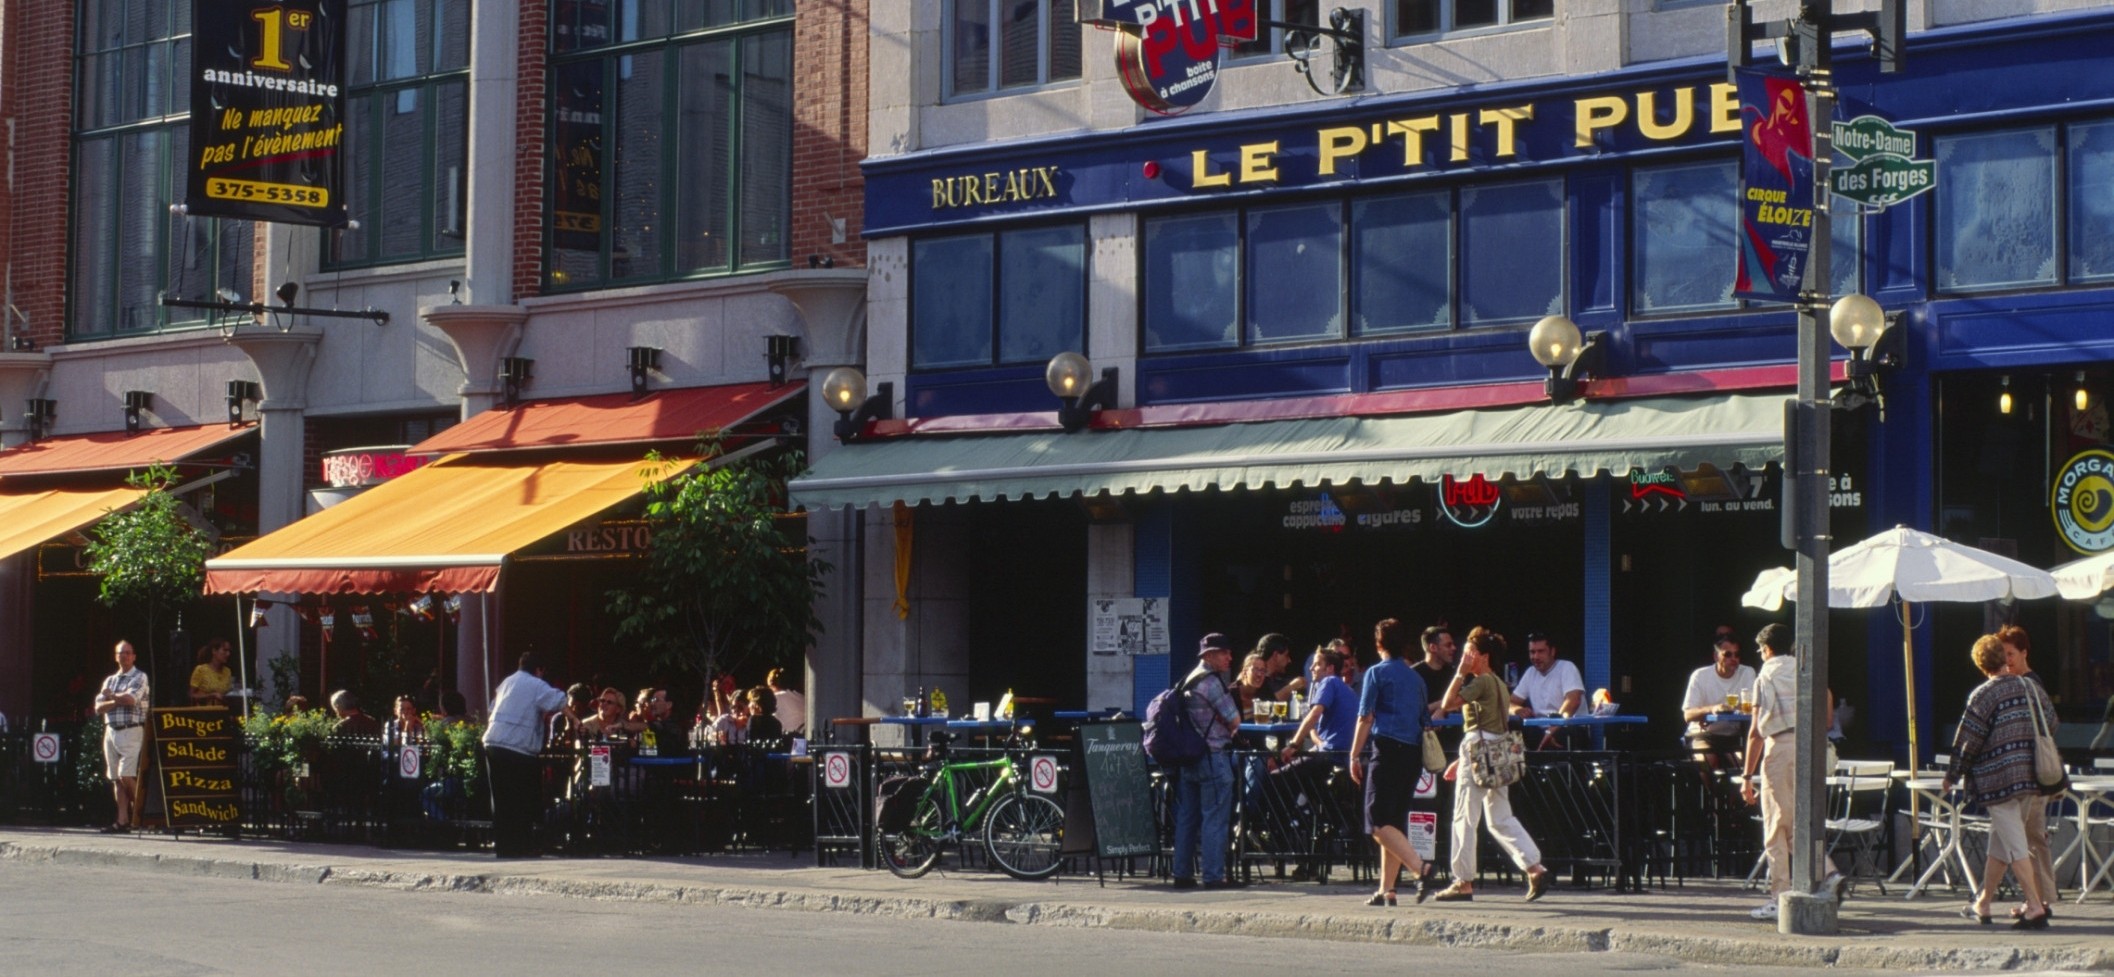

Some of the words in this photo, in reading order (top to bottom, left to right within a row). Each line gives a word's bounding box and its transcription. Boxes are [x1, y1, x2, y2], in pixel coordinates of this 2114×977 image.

[251, 6, 312, 72] 1er
[203, 68, 338, 97] anniversaire
[1160, 86, 1169, 99] à
[1169, 70, 1215, 96] chansons
[221, 107, 243, 130] Ne
[249, 104, 323, 131] manquez
[201, 142, 235, 170] pas
[242, 123, 343, 160] l'évènement
[1192, 140, 1279, 188] LE
[1318, 103, 1534, 175] P'TIT
[1835, 126, 1911, 154] Notre-Dame
[932, 166, 1058, 208] BUREAUX
[1838, 170, 1867, 191] des
[1872, 168, 1928, 191] Forges
[214, 181, 320, 204] 375-5358
[1747, 187, 1787, 203] CIRQUE
[1757, 201, 1812, 227] ÉLOIZE
[1511, 506, 1542, 519] votre
[1546, 502, 1579, 518] repas
[1701, 500, 1722, 512] lun.
[1725, 501, 1740, 511] au
[1743, 498, 1775, 511] vend.
[568, 526, 651, 552] RESTO
[162, 713, 223, 737] Burger
[167, 742, 227, 761] Salade
[1087, 739, 1139, 756] Tanqueray
[170, 771, 232, 790] Pizza
[173, 800, 239, 821] Sandwich
[1106, 845, 1128, 856] Simply
[1129, 843, 1151, 852] Perfect
